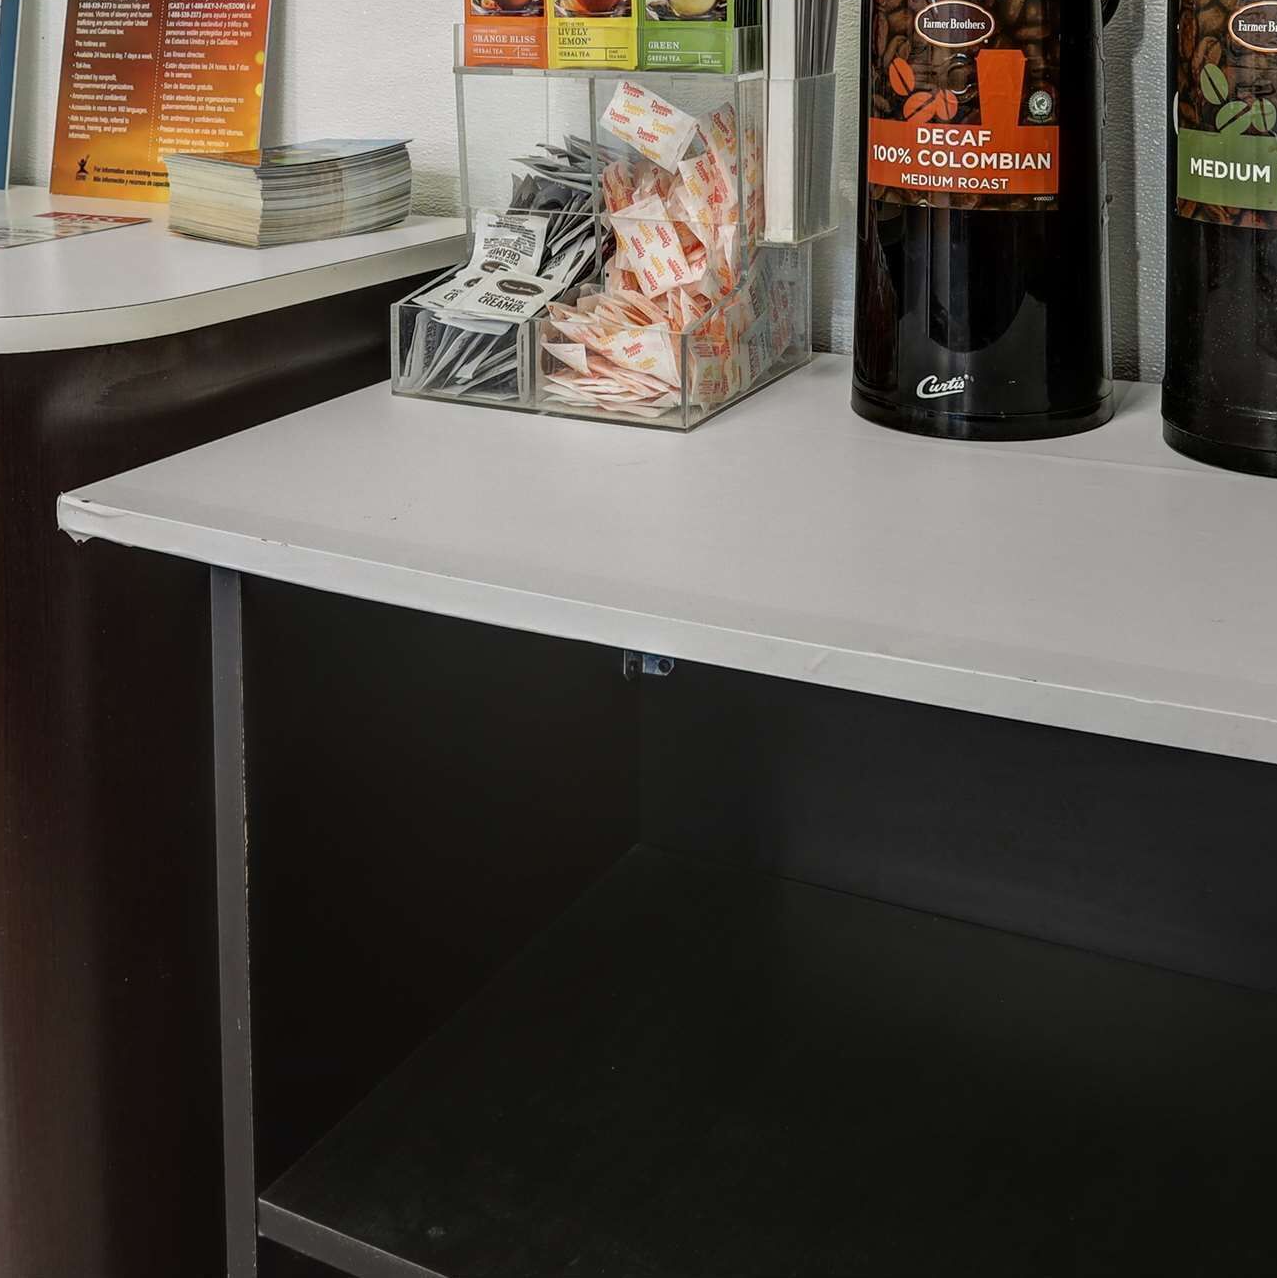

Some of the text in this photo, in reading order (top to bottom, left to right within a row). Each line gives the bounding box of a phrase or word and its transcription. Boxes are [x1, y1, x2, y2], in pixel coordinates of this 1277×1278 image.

[558, 28, 588, 36] LIVELY
[923, 18, 986, 30] Farmer Brothers
[1238, 19, 1267, 33] Farmer
[472, 34, 536, 43] ORANGE BLISS
[648, 42, 680, 50] GREEN
[917, 128, 991, 147] DECAF
[873, 144, 1052, 170] 100% COLOMBIAN
[1190, 157, 1271, 183] MEDIUM
[901, 173, 1009, 190] MEDIUM ROAST
[478, 296, 524, 313] CREAMER
[916, 374, 965, 399] Curtis
